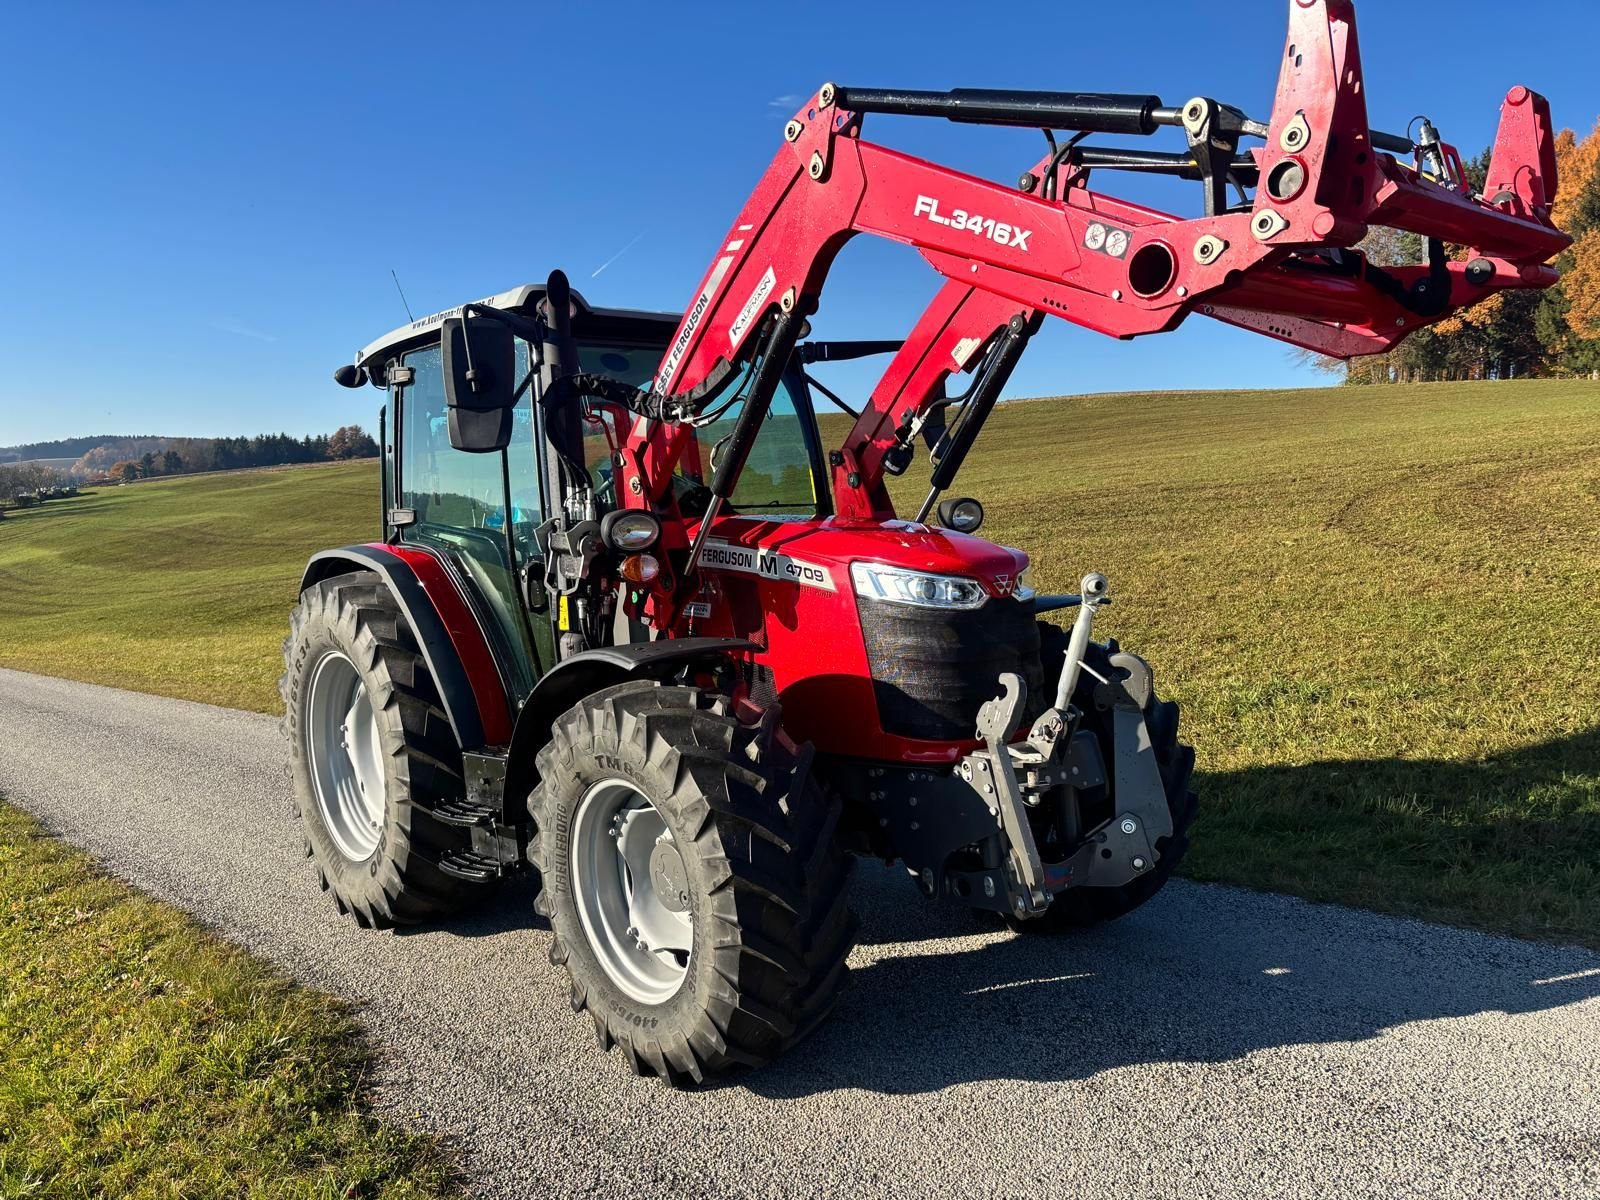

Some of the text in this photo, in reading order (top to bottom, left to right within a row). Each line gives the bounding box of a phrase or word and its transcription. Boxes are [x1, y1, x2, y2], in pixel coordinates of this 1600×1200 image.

[913, 194, 1033, 251] FL.3416X
[672, 293, 709, 362] FERGUSON
[702, 549, 824, 583] FERGUSON M 4709
